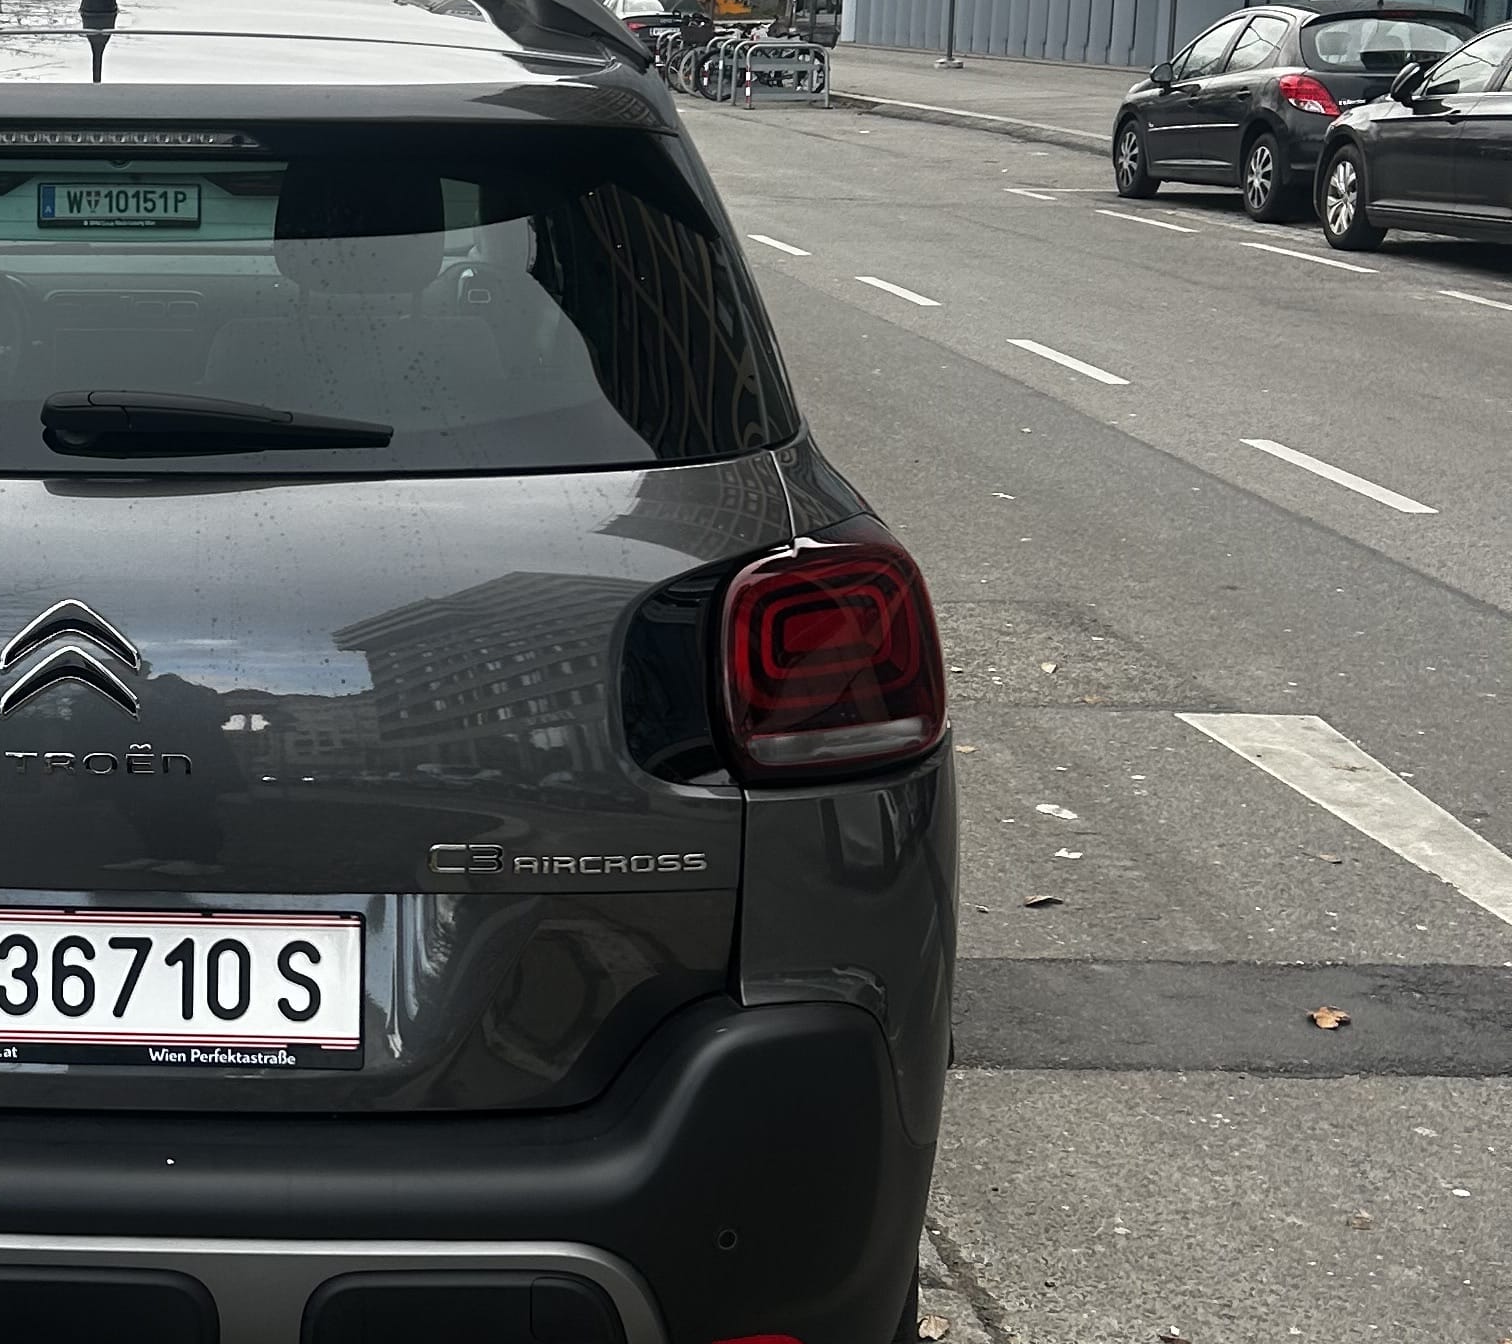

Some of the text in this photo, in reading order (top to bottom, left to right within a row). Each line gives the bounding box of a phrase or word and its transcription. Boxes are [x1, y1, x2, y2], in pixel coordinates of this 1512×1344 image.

[428, 843, 505, 874] C3
[277, 938, 322, 1022] S
[149, 1047, 297, 1065] Wien Perfektastraße
